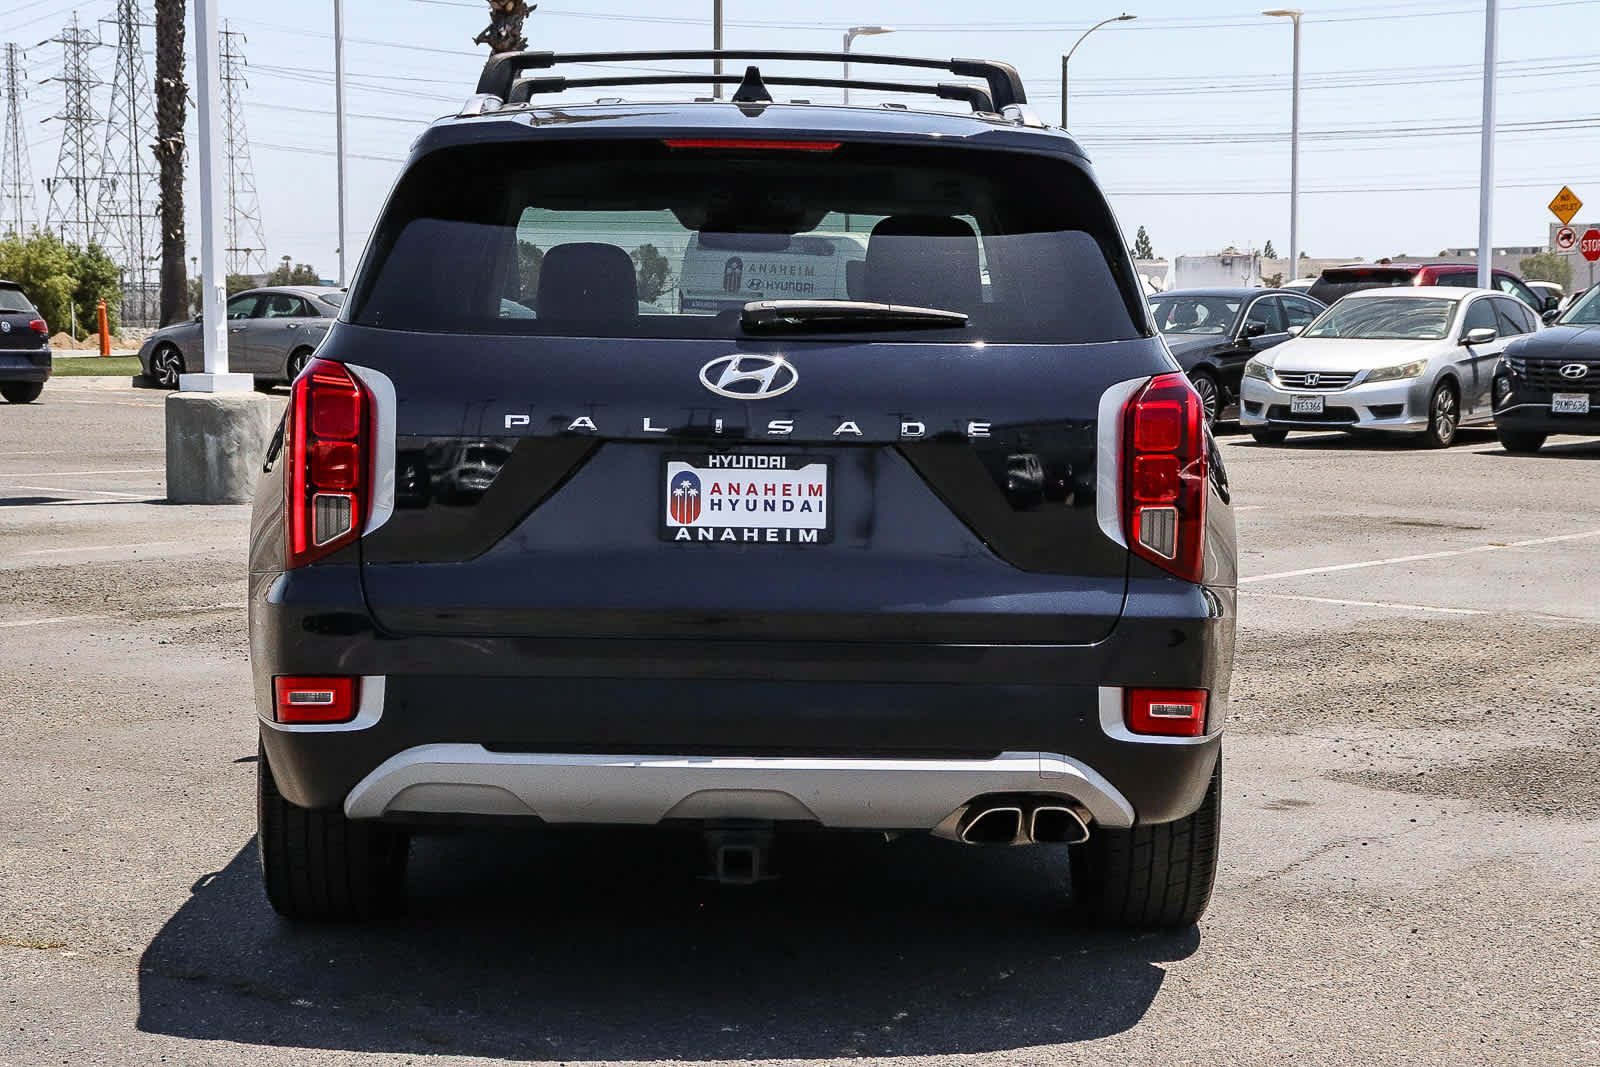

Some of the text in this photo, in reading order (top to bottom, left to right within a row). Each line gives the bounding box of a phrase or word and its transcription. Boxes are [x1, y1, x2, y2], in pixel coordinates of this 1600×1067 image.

[1553, 203, 1578, 211] OUTLET
[749, 264, 815, 276] ANAHEIM
[766, 280, 814, 293] HYUNDAI
[1555, 400, 1587, 410] 9KMP636
[504, 414, 992, 438] PALISADE
[708, 454, 786, 469] HYUNDAI
[710, 482, 823, 497] ANAHEIM
[710, 498, 823, 513] HYUNDAI
[674, 527, 818, 543] ANAHEIM
